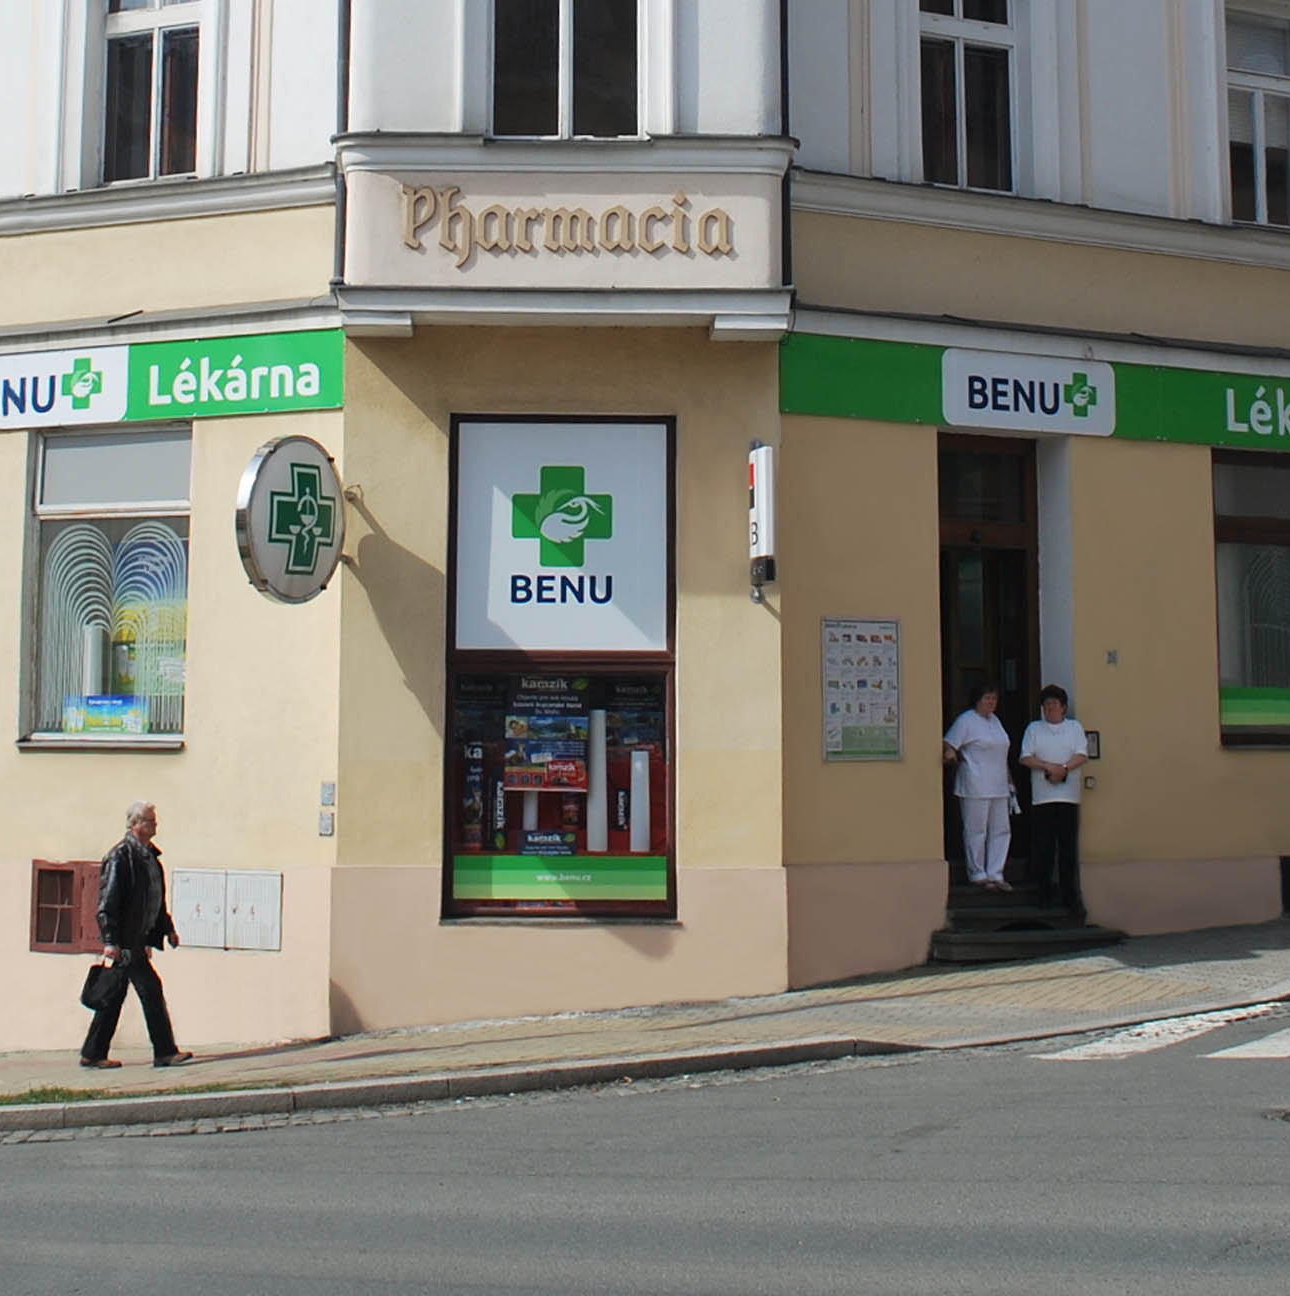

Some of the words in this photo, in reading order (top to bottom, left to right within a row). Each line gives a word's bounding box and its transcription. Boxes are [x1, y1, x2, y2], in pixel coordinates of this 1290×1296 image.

[402, 183, 733, 268] Pharmacia
[149, 354, 320, 405] Lékárna
[967, 375, 1060, 416] BENU
[511, 575, 613, 604] BENU
